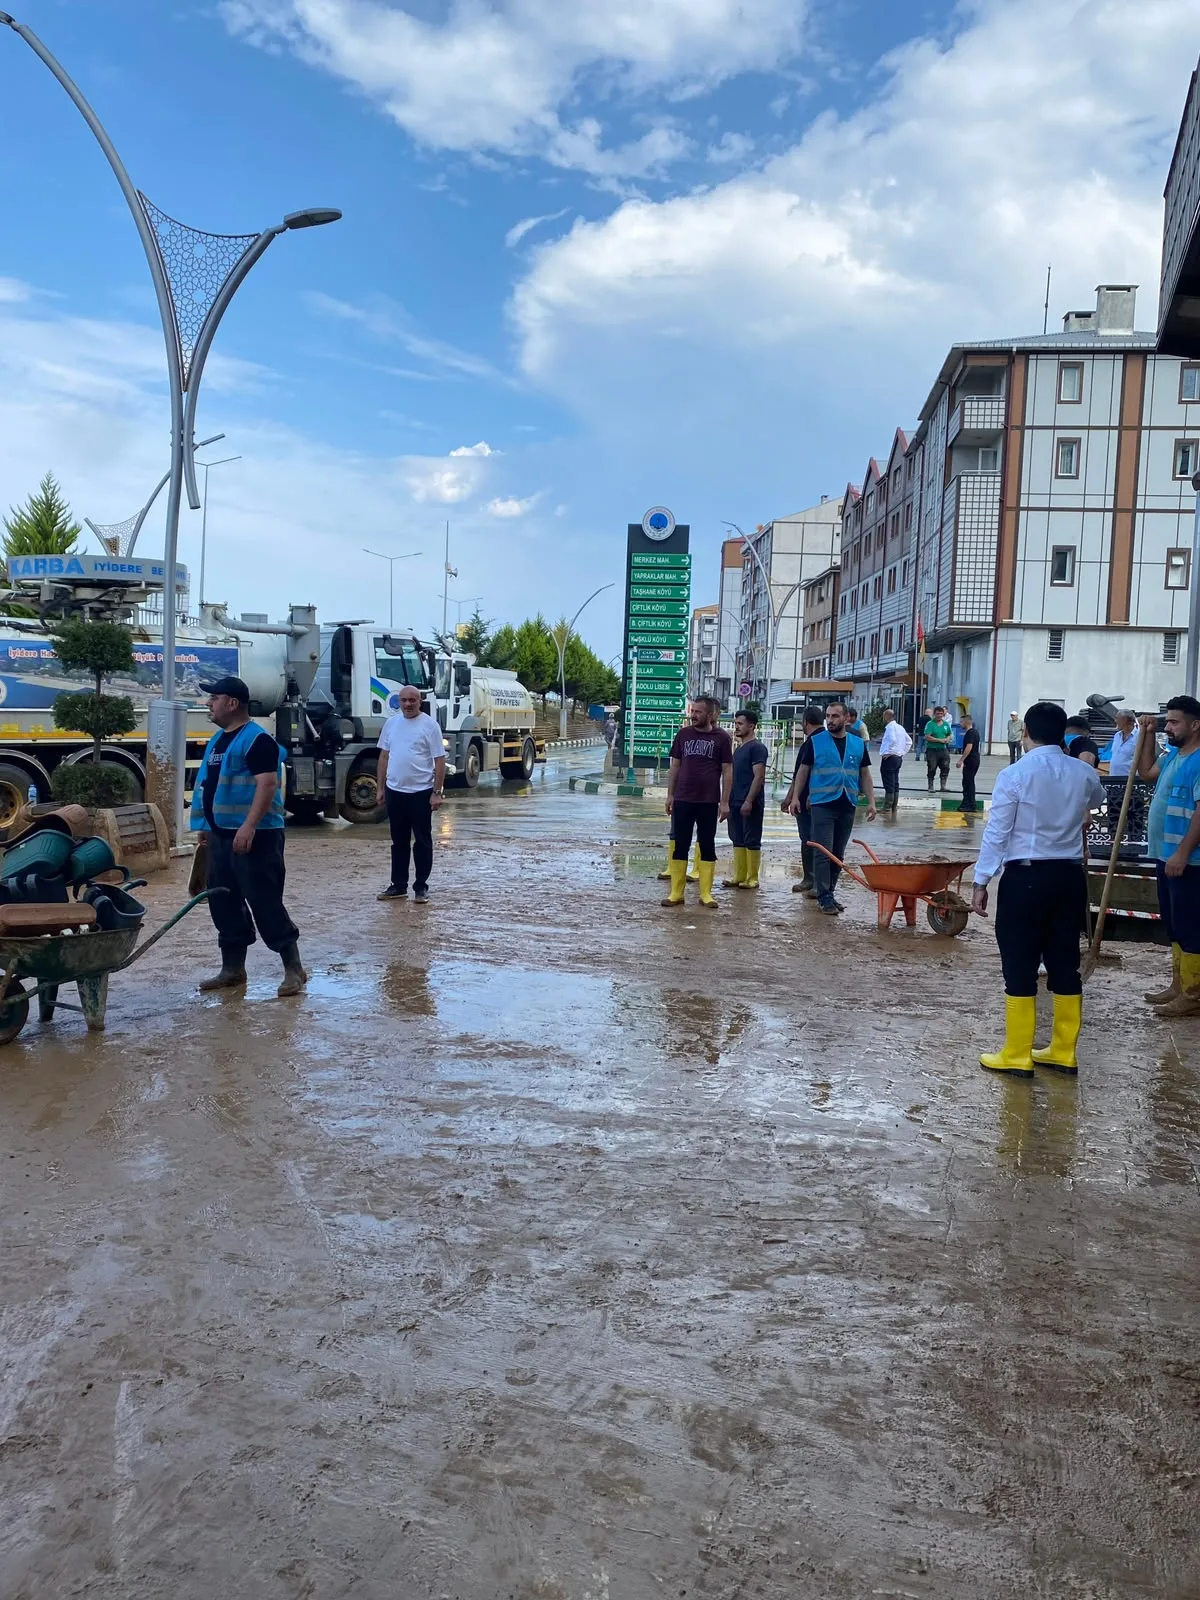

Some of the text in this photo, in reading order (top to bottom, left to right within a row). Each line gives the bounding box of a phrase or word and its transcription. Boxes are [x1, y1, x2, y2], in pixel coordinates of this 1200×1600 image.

[634, 556, 656, 564] MERKEZ
[10, 558, 85, 576] KARBA
[634, 572, 664, 580] YAPRAKLAR
[633, 588, 672, 596] TAŞHANE KÖYÜ
[632, 603, 667, 612] ÇİFTLİK KÖYÜ
[637, 619, 656, 628] ÇİFTLİK
[656, 619, 672, 628] KÖYÜ
[652, 635, 667, 644] KÖYÜ
[9, 646, 38, 660] İyidere
[629, 682, 670, 690] AADOLU LİSESİ
[642, 698, 658, 706] EĞİTİM
[627, 730, 645, 738] EDİNÇ
[646, 730, 656, 738] ÇAY
[648, 746, 657, 754] ÇAY
